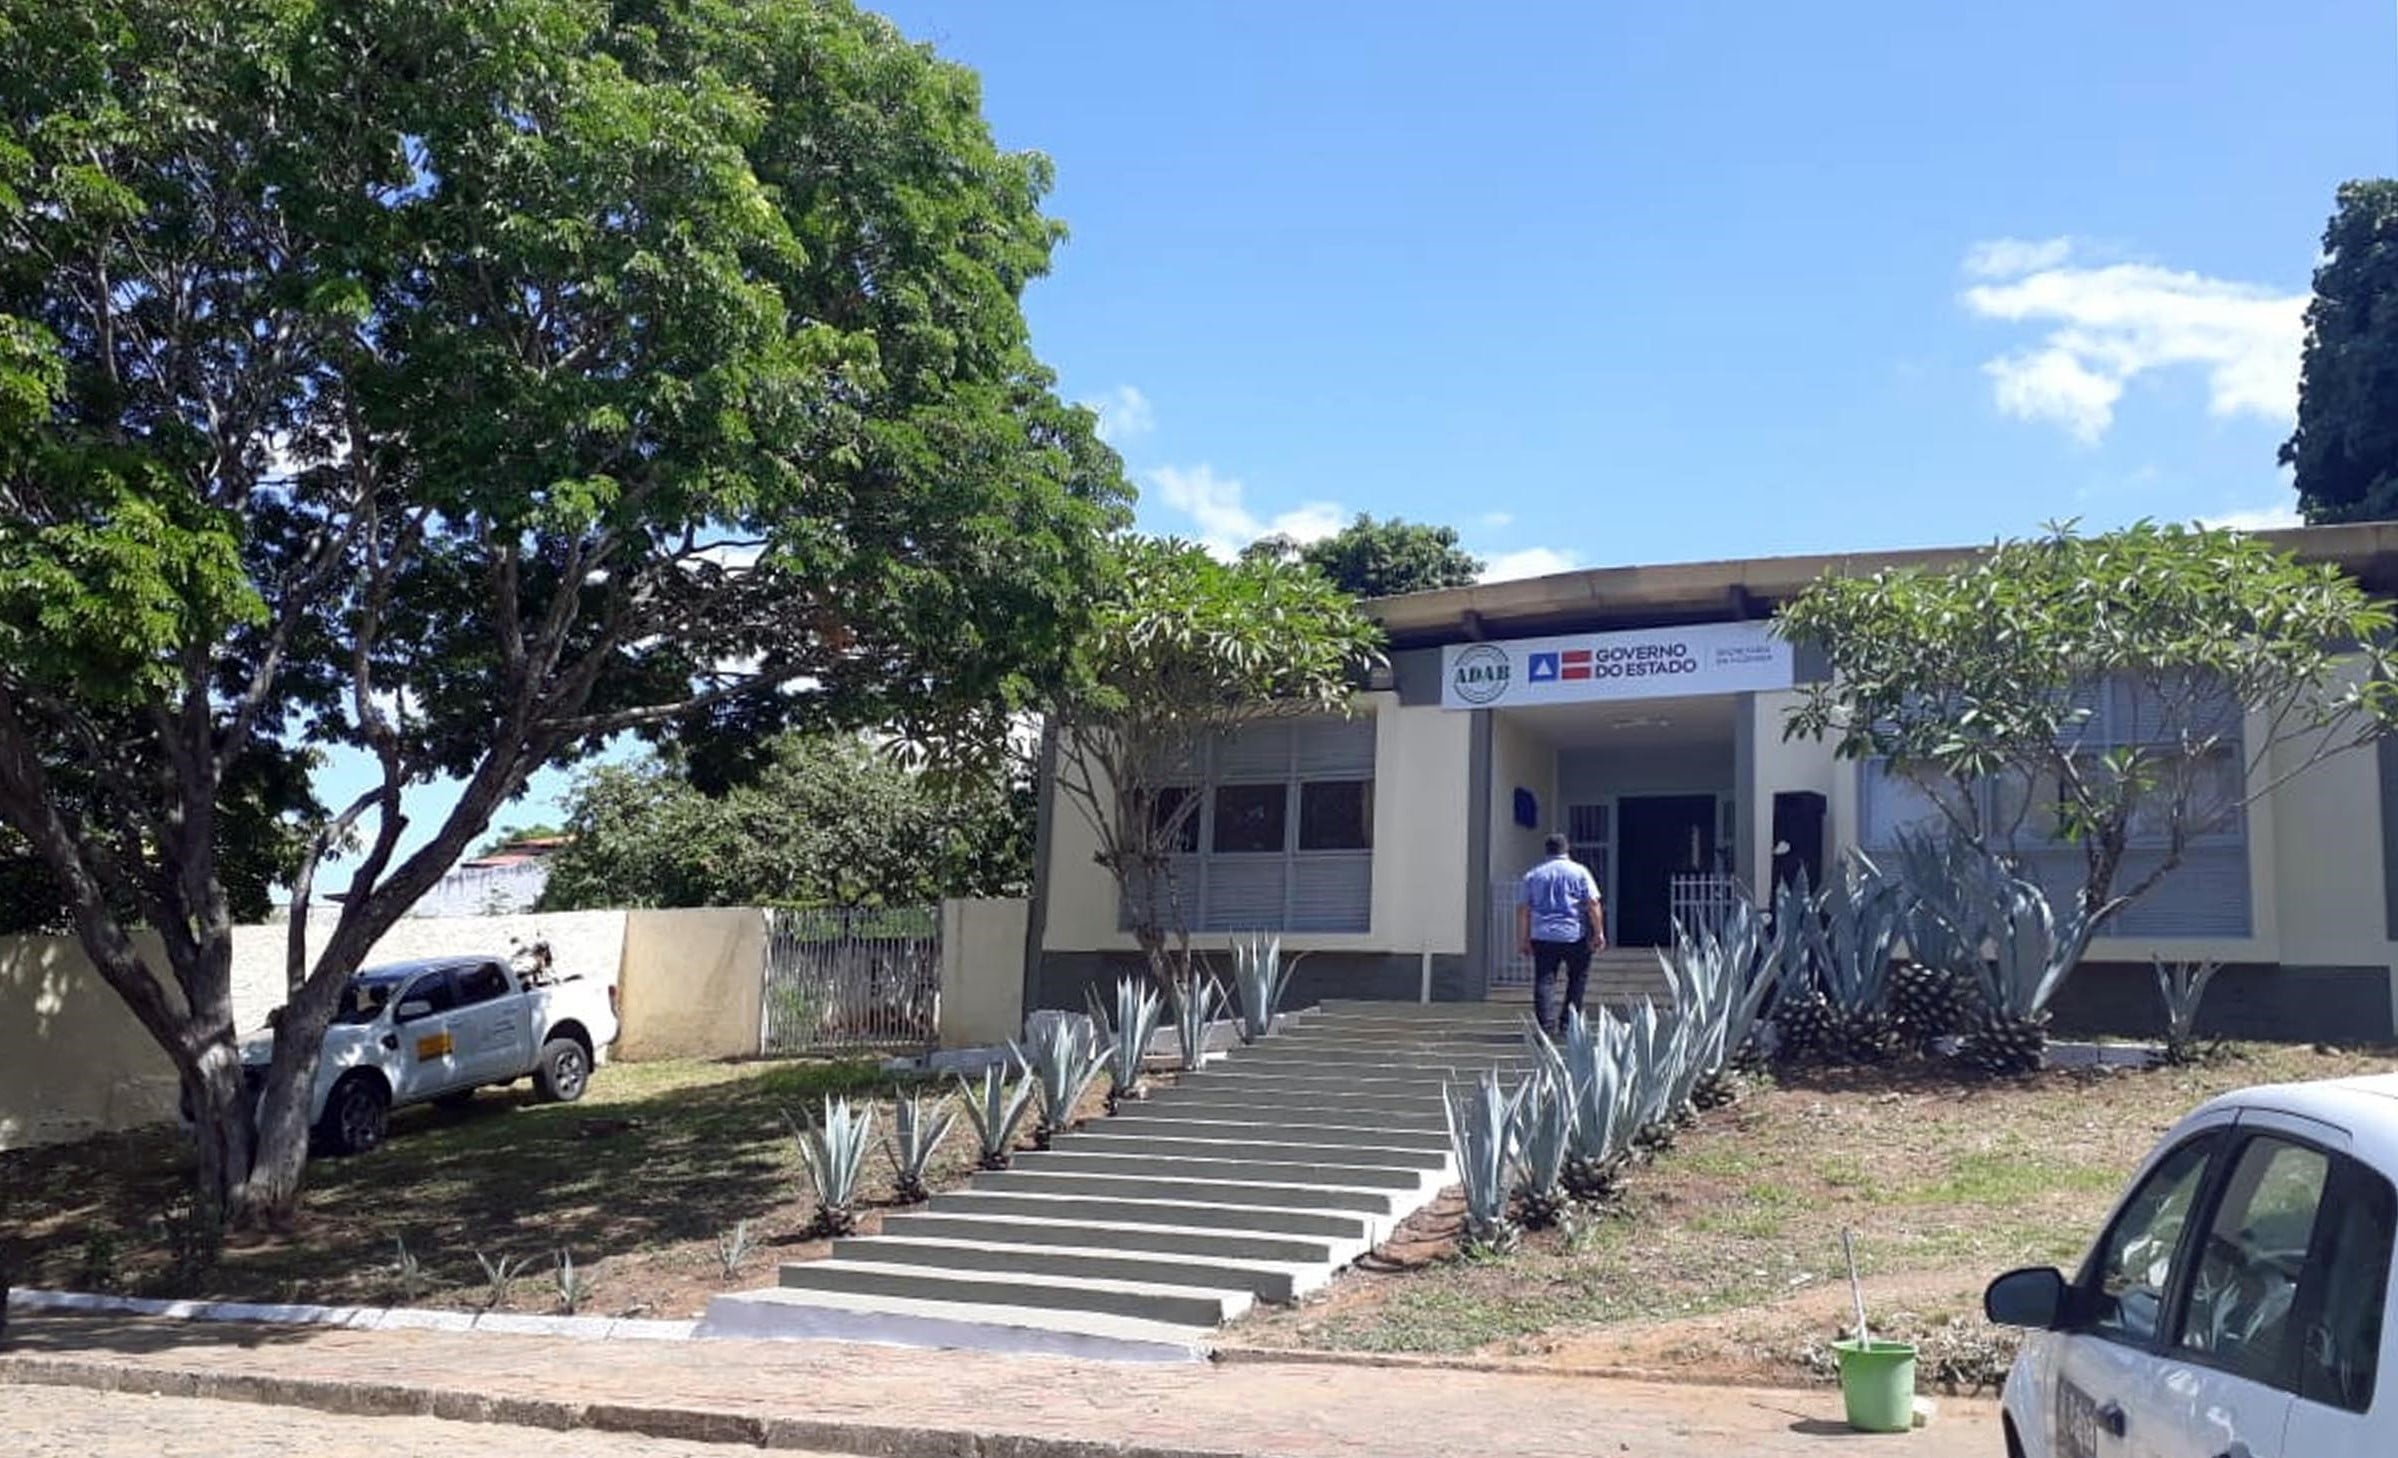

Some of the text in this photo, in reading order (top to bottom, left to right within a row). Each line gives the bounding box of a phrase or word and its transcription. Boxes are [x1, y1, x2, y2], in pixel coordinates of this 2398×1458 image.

[1596, 643, 1687, 663] GOVERNO
[1455, 665, 1510, 684] ADAB
[1595, 664, 1623, 679] DO
[1626, 659, 1697, 677] ESTADO
